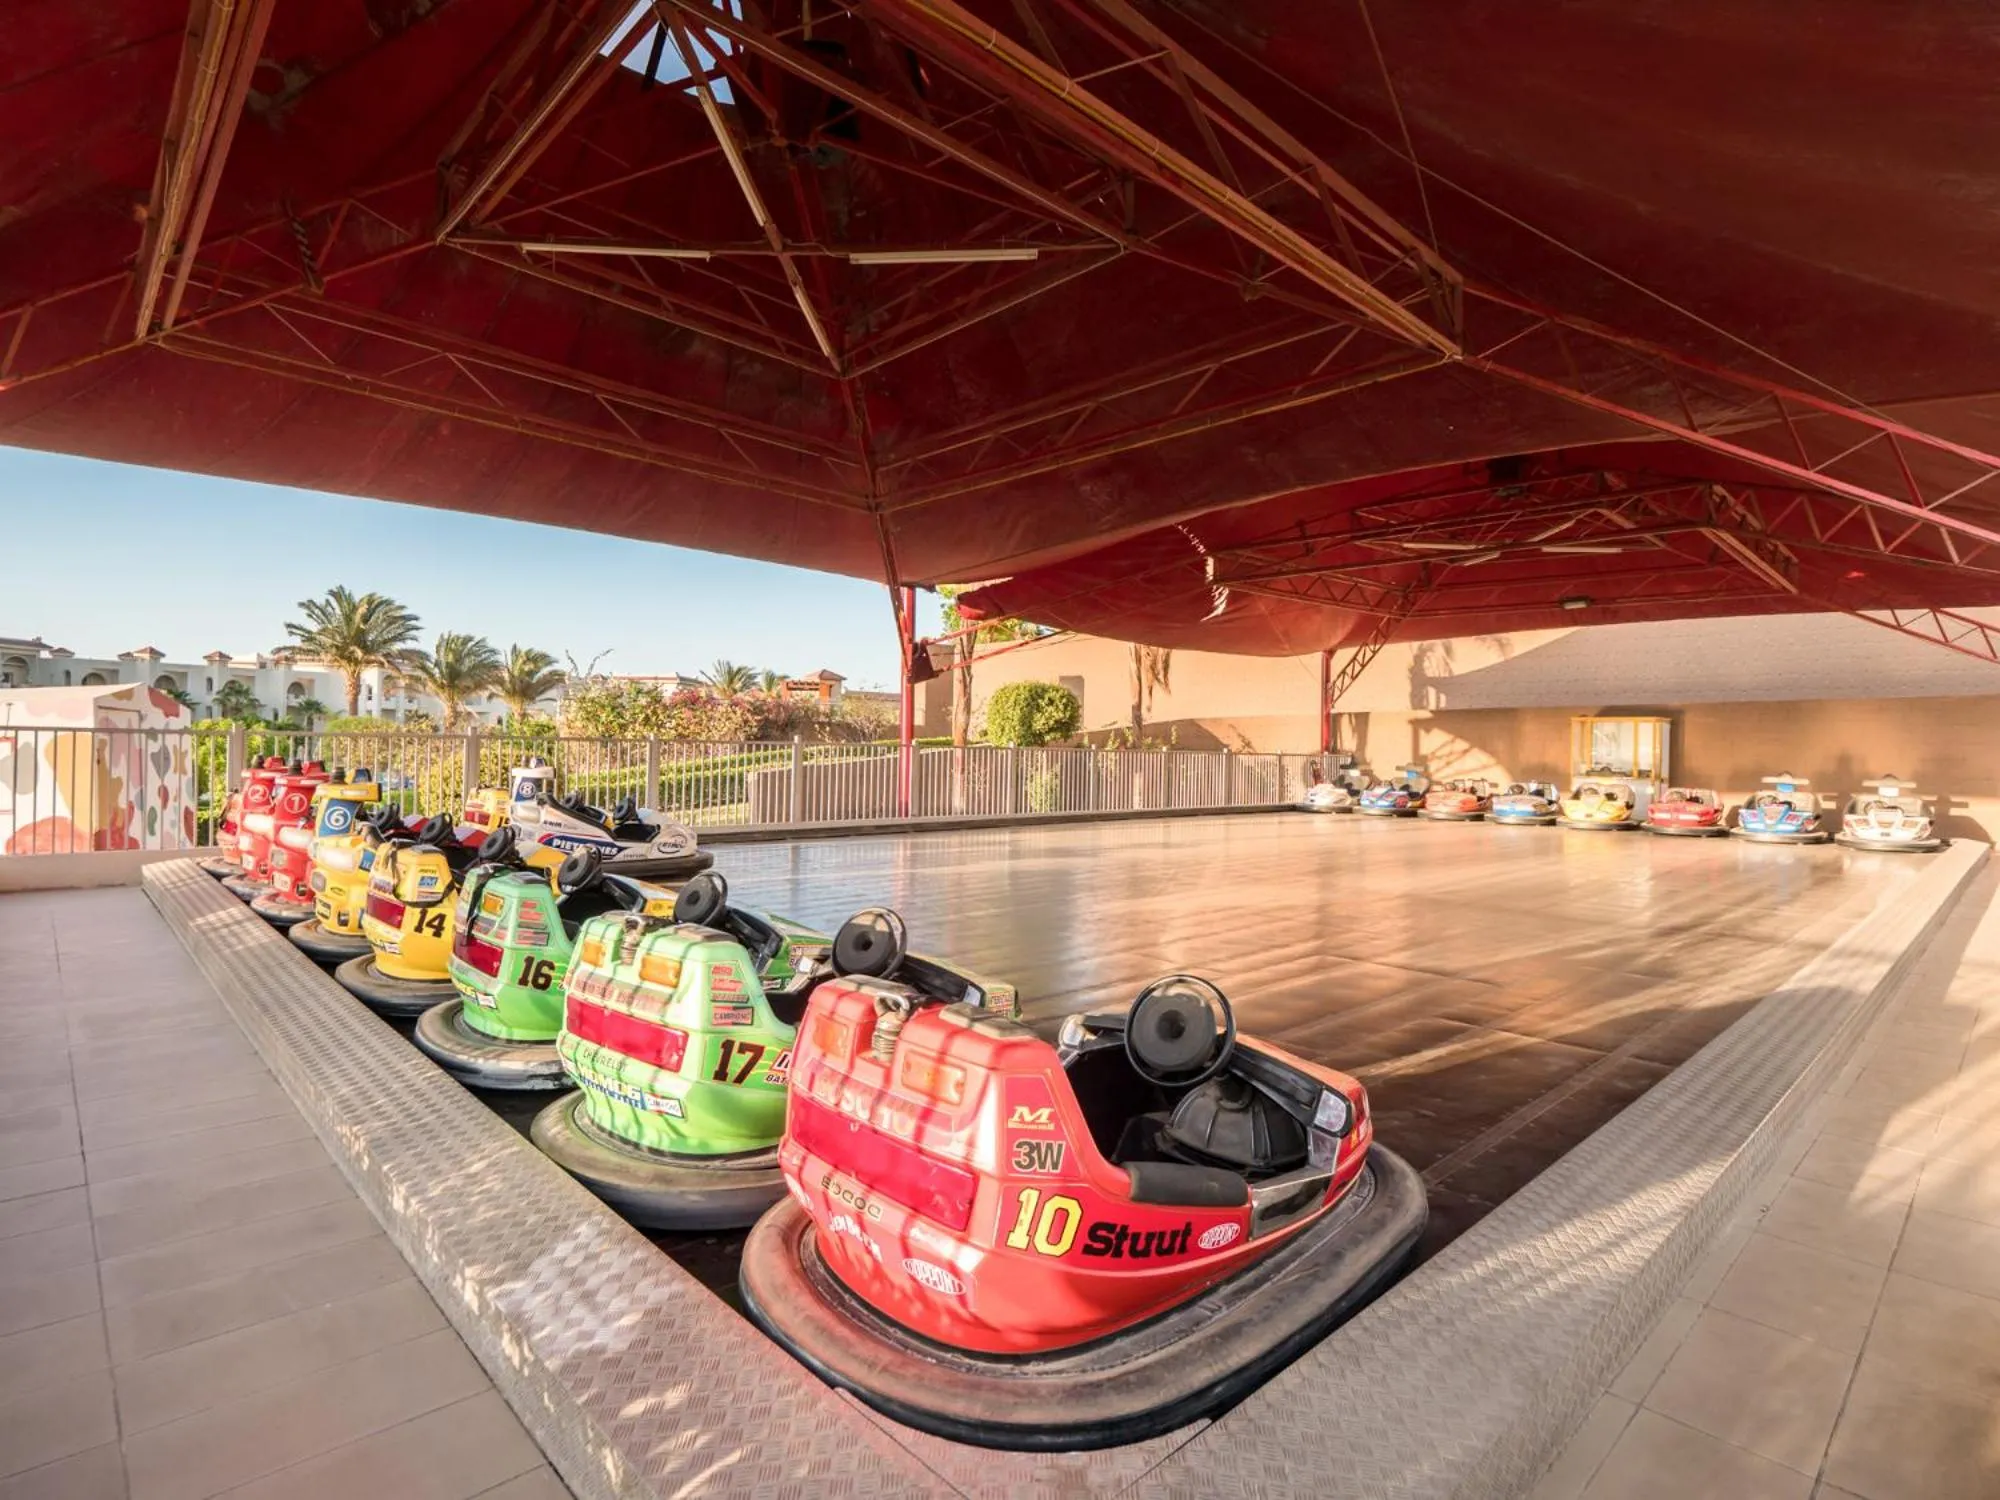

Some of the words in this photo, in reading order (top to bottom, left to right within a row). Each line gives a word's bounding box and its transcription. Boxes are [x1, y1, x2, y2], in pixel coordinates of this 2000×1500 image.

[249, 786, 266, 802] 2
[329, 810, 346, 825] 6
[414, 908, 447, 938] 14
[517, 956, 556, 991] 16
[712, 1038, 766, 1086] 17
[1011, 1105, 1055, 1122] M
[1012, 1139, 1065, 1172] 3W
[1005, 1186, 1084, 1257] 10
[1081, 1220, 1192, 1258] Stuut
